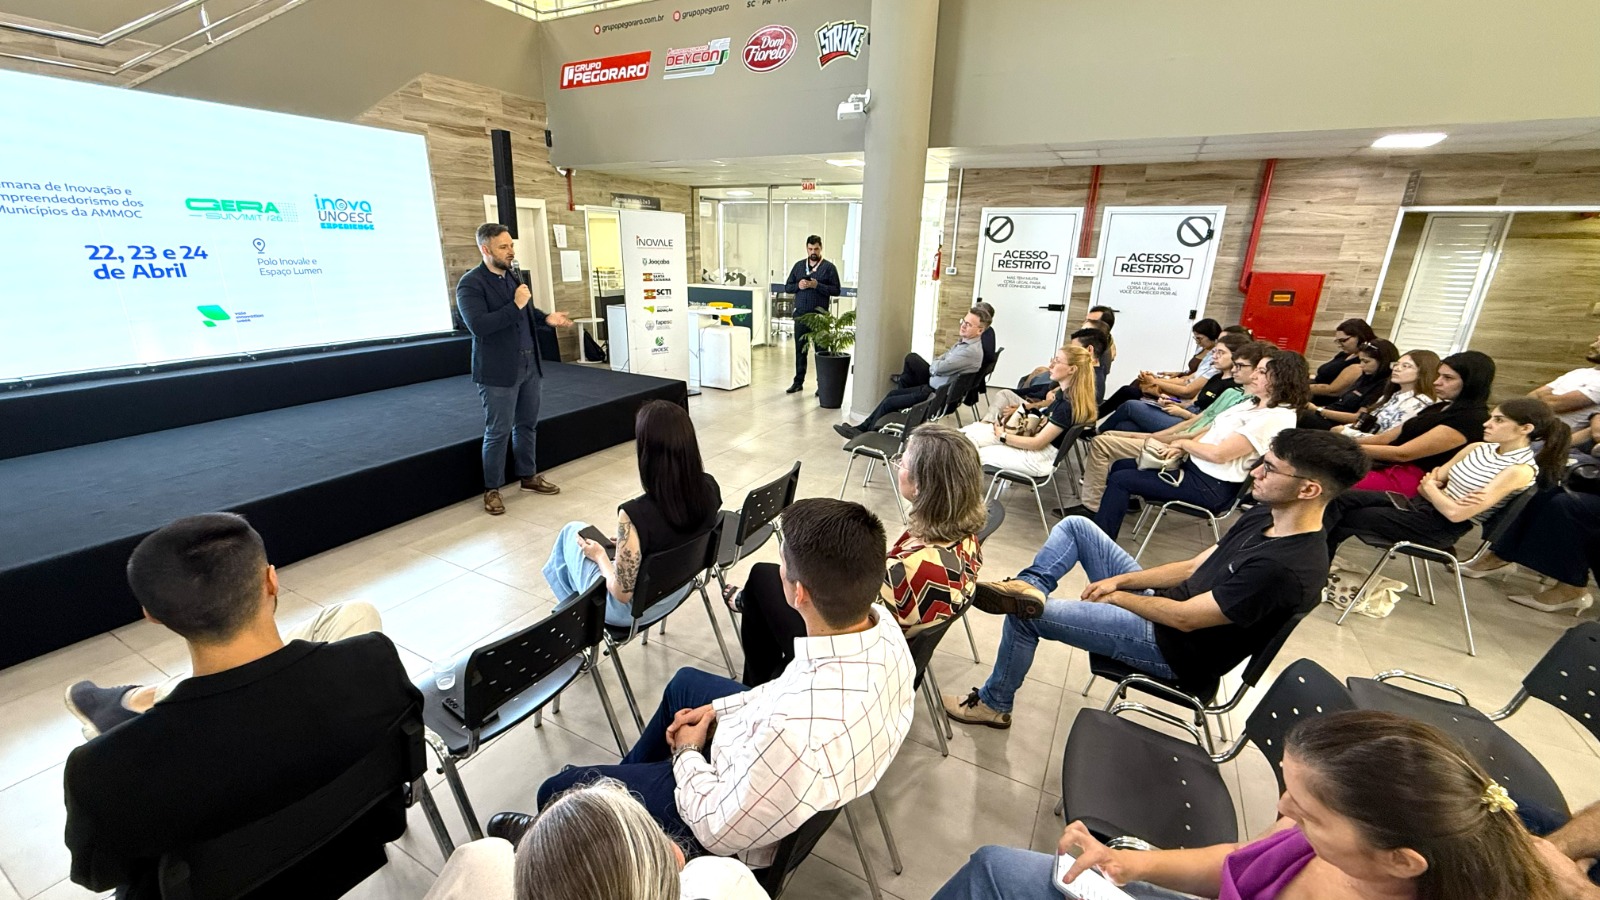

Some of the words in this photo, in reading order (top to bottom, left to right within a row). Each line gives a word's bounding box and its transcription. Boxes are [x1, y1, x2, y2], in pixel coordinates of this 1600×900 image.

[682, 3, 730, 19] grupopegoraro
[602, 14, 665, 33] grupopegoraro.com.br
[761, 35, 784, 49] Dom
[666, 49, 720, 66] DEYCON
[747, 45, 787, 63] Fiorelo
[575, 61, 602, 72] GRUPO
[573, 63, 647, 85] PEGORARO
[0, 181, 41, 191] mana
[44, 181, 62, 191] de
[64, 183, 122, 196] Inovação
[122, 198, 144, 207] dos
[185, 198, 280, 213] GERA
[314, 193, 372, 212] inova
[71, 207, 87, 216] da
[91, 208, 143, 218] AMMOC
[205, 212, 262, 222] SUMMIT
[318, 210, 373, 224] UNOESC
[84, 245, 125, 263] 22,
[127, 245, 158, 260] 23
[162, 248, 177, 260] e
[179, 245, 209, 260] 24
[1003, 250, 1048, 260] ACESSO
[1127, 252, 1181, 264] ACESSO
[257, 257, 278, 266] Polo
[279, 257, 311, 266] Inovale
[997, 259, 1051, 270] RESTRITO
[93, 263, 126, 280] de
[132, 262, 188, 279] Abril
[259, 267, 292, 278] Espaço
[293, 267, 323, 275] Lumen
[1120, 263, 1184, 275] RESTRITO
